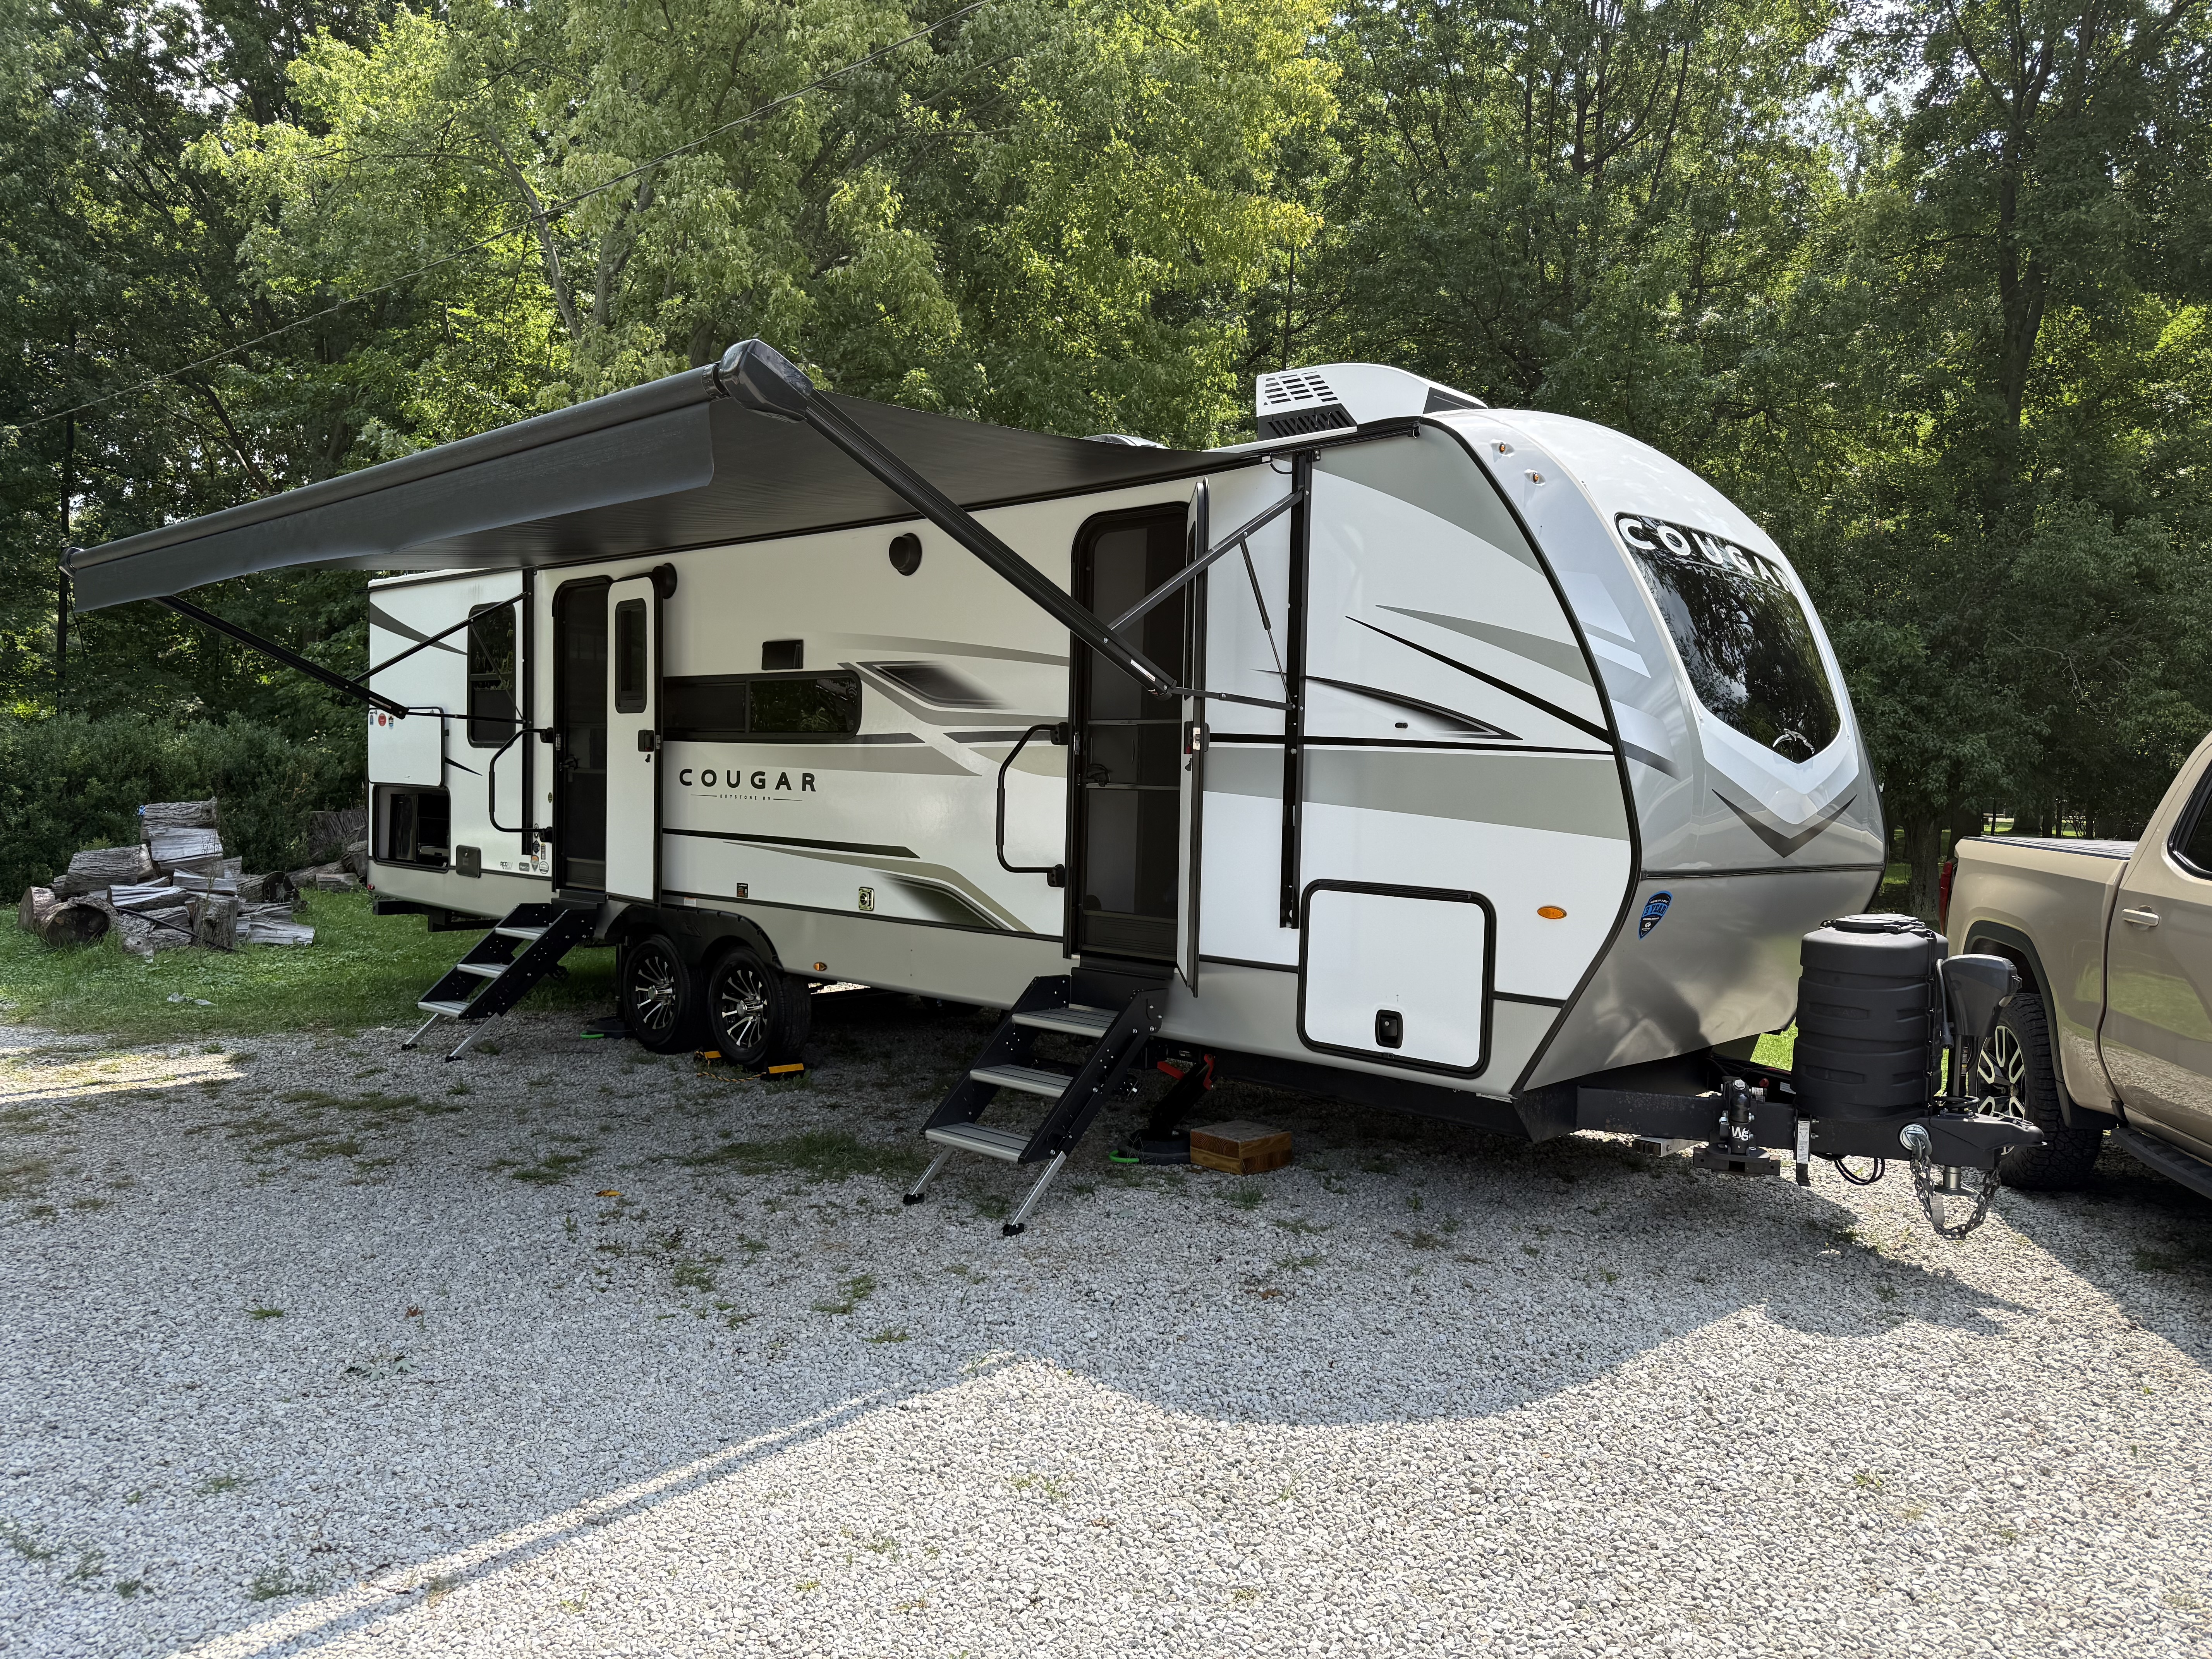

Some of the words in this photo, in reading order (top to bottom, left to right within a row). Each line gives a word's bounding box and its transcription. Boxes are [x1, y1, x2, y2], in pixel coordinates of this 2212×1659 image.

[1618, 518, 1790, 592] COUGAR
[679, 768, 816, 792] COUGAR
[1644, 906, 1650, 915] 3
[1650, 904, 1666, 914] YEAR
